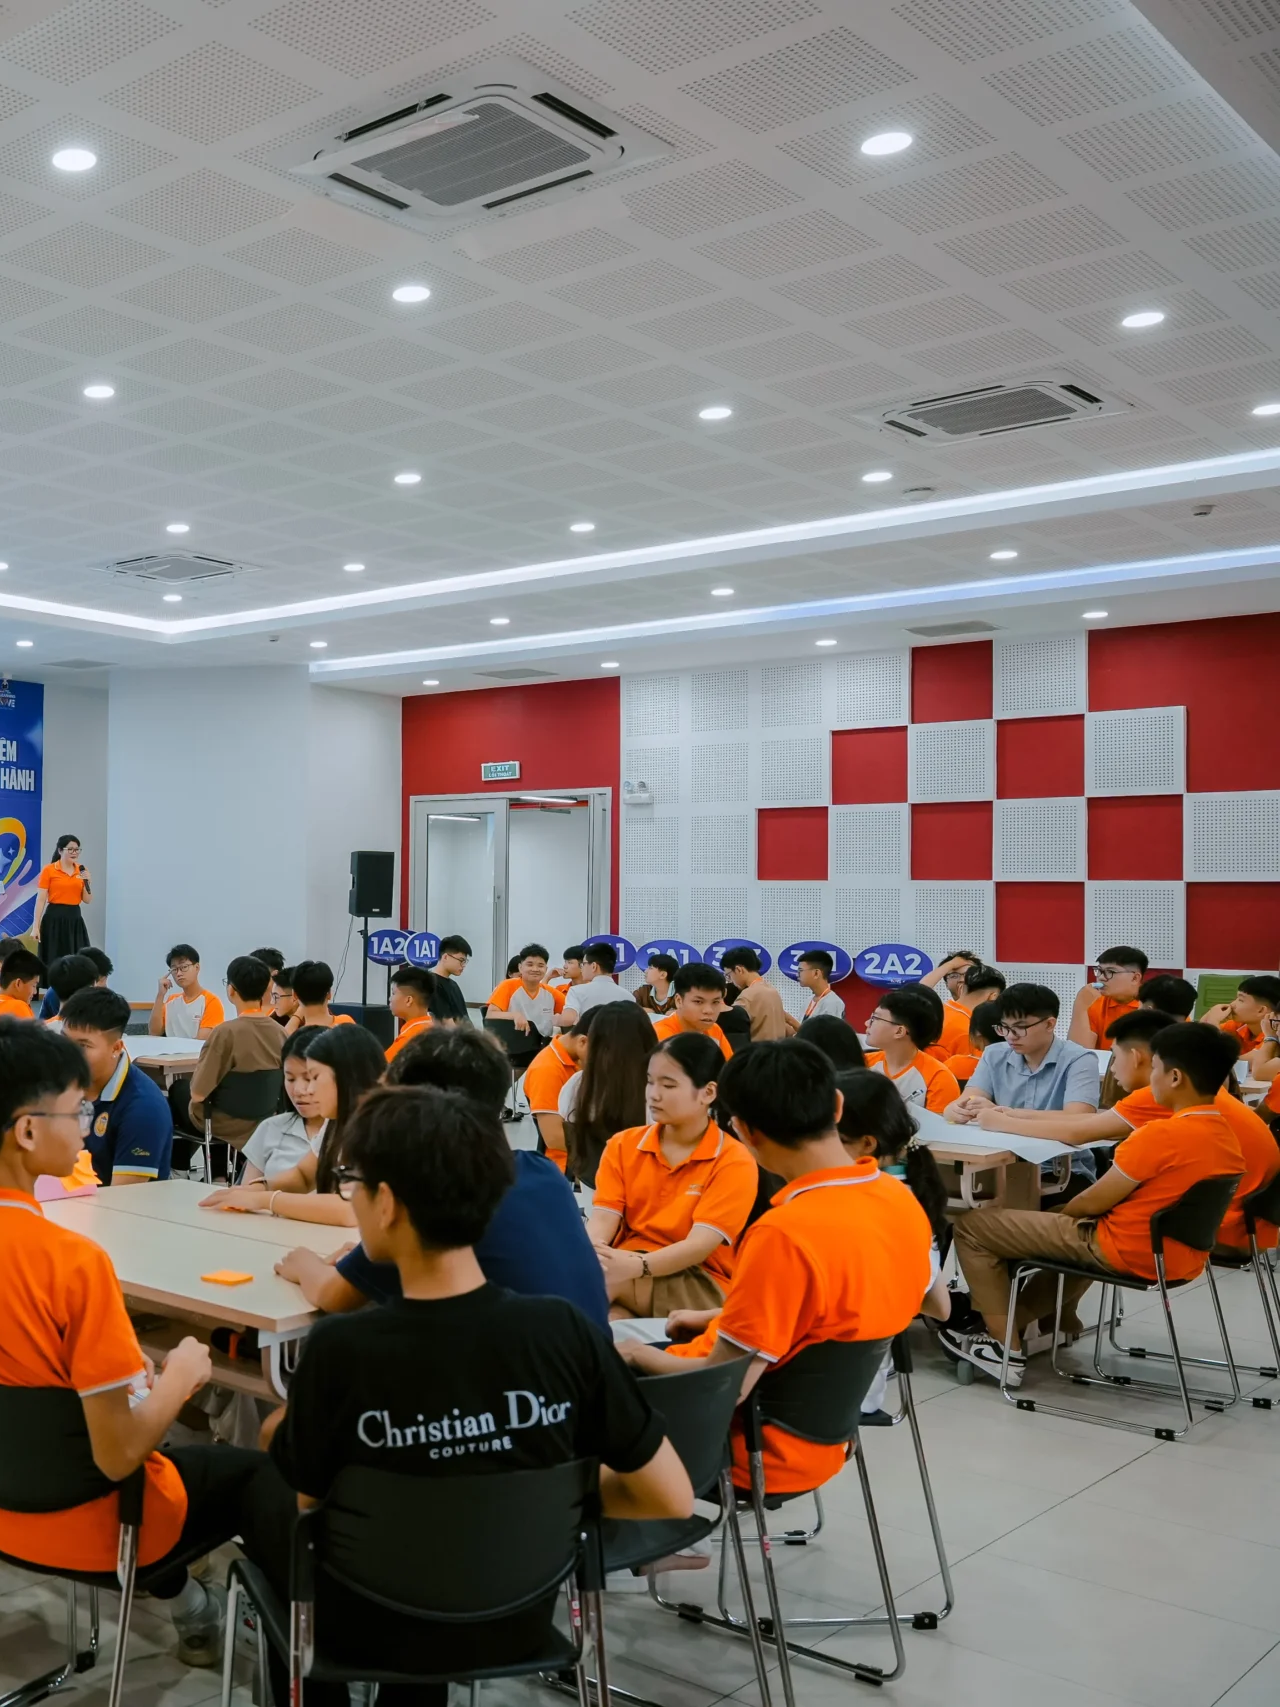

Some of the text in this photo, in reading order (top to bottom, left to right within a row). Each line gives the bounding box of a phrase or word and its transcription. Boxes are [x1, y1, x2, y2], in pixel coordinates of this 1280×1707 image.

[371, 936, 405, 955] 1A2
[414, 939, 437, 958] 1A1
[864, 952, 923, 976] 2A2
[357, 1390, 572, 1448] Christian Dior
[429, 1436, 513, 1460] COUTURE
